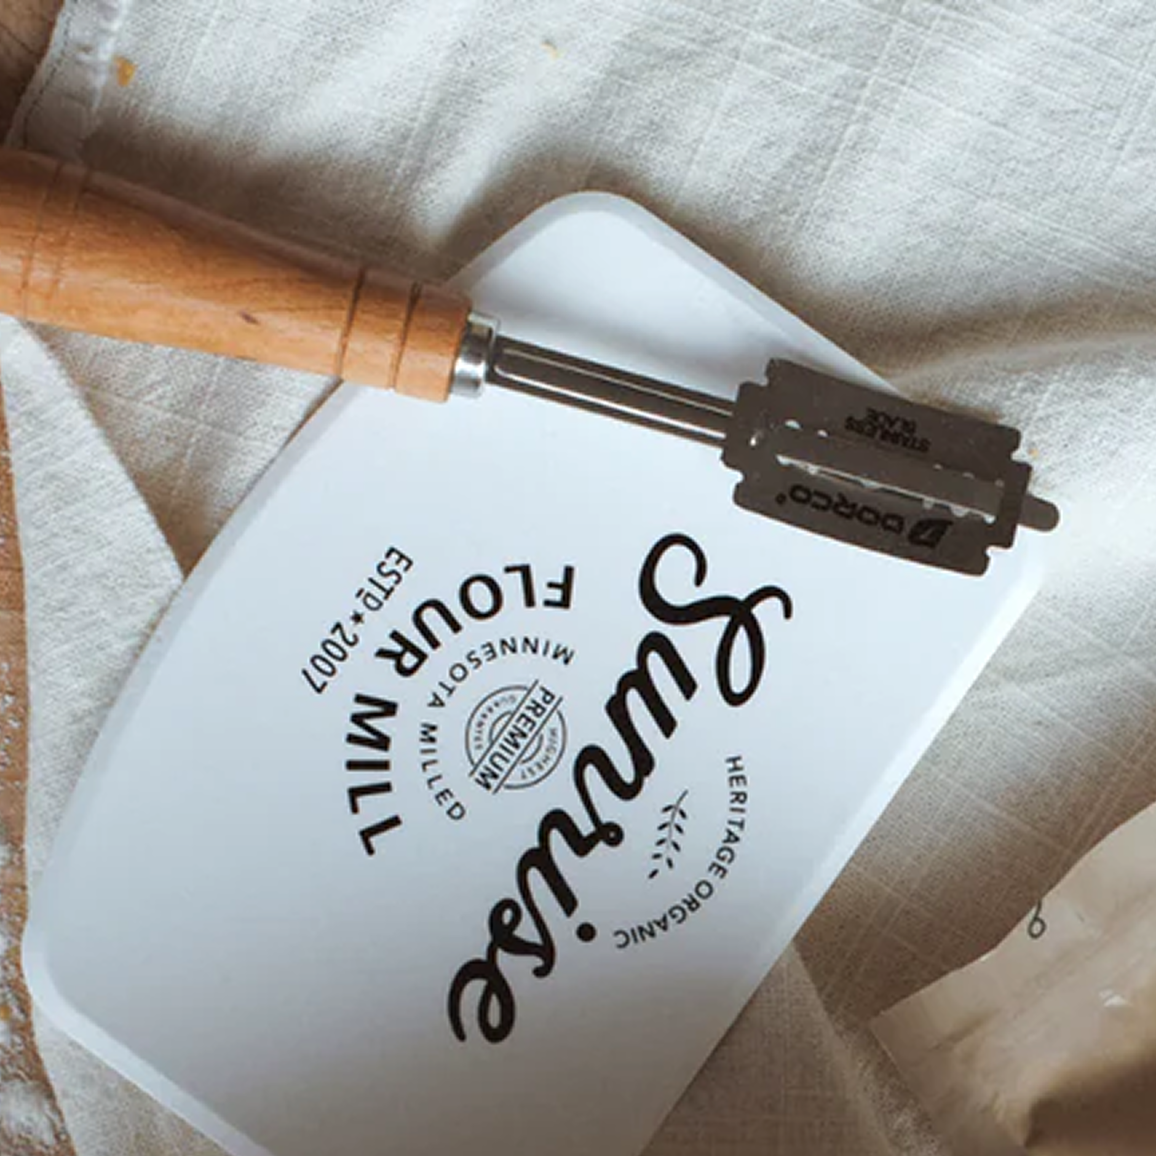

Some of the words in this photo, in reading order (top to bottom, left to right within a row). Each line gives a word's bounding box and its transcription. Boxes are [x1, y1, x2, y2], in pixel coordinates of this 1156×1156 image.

[788, 484, 906, 532] DORCO
[375, 563, 575, 678] FLOUR
[426, 636, 575, 710] MINNESOTA
[345, 693, 402, 856] MILL
[418, 722, 467, 822] MILLED
[446, 532, 794, 1044] Sunrise
[474, 685, 556, 791] PREMIUM
[708, 755, 748, 879] HERITAGE
[614, 880, 715, 950] ORGANIC
